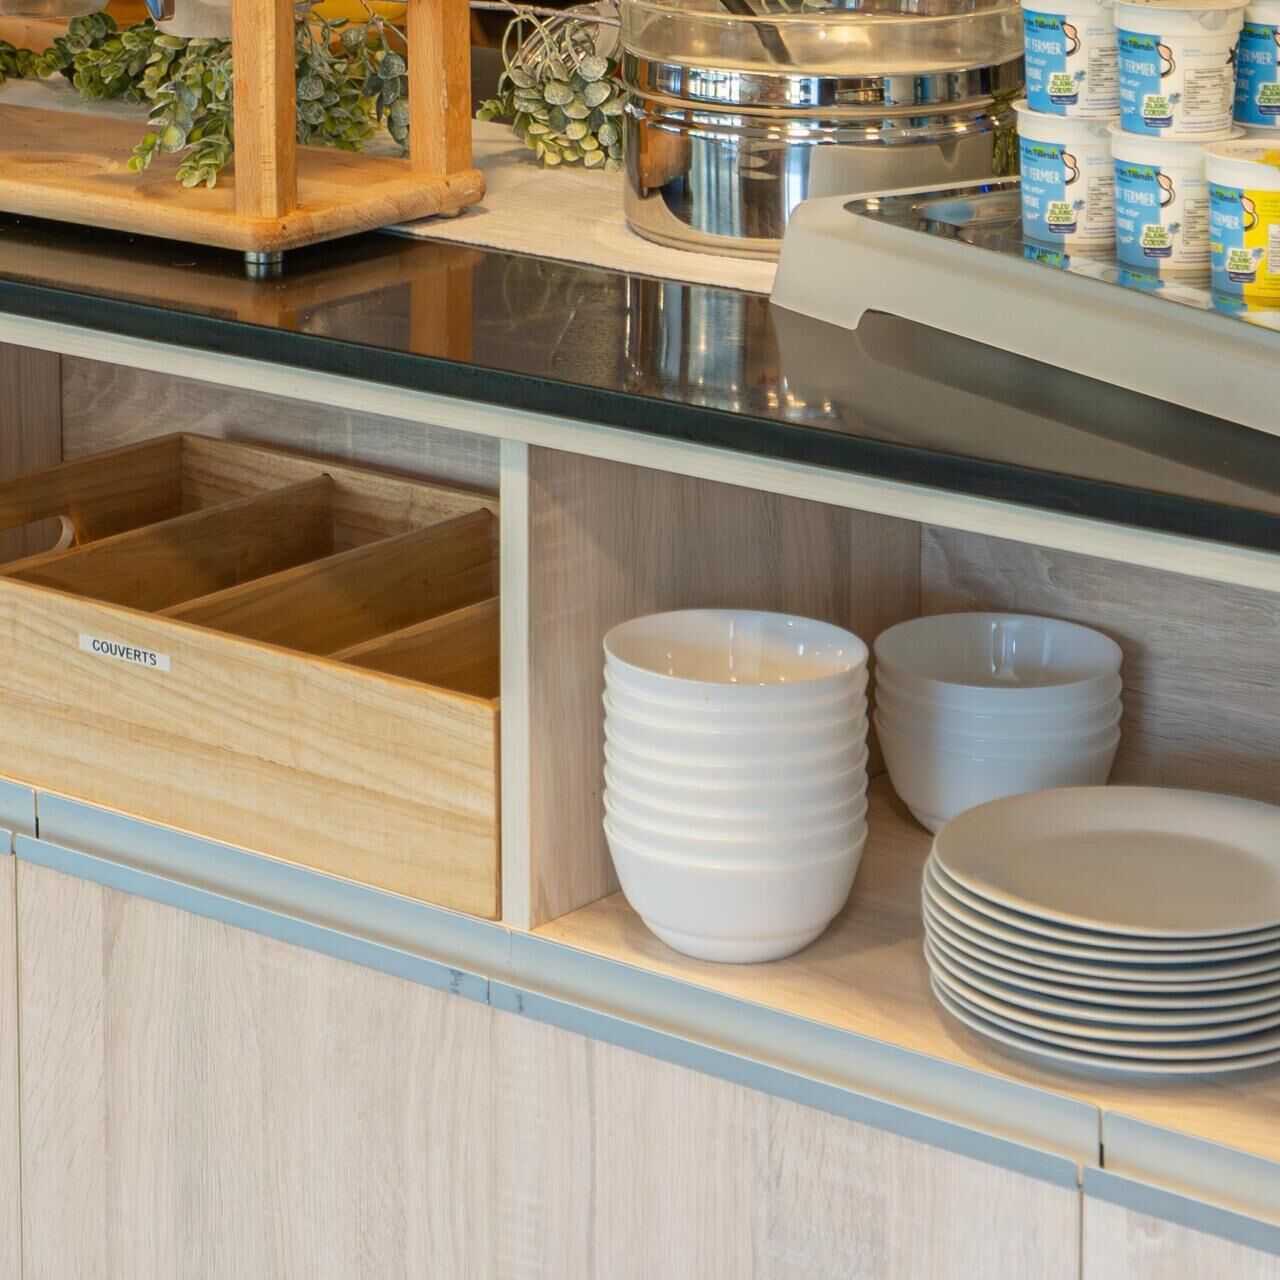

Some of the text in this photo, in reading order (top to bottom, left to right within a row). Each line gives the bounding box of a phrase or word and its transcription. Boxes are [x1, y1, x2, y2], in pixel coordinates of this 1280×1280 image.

[1031, 39, 1063, 56] FERMIER
[1125, 59, 1158, 77] FERMIER
[1051, 80, 1074, 88] BLANC
[1144, 102, 1169, 110] BLANC
[1030, 168, 1063, 185] FERMIER
[1124, 190, 1158, 207] FERMIER
[1050, 208, 1074, 216] BLANC
[1147, 225, 1166, 233] BLEU
[1144, 231, 1169, 239] BLANC
[1231, 249, 1249, 257] BLEU
[1229, 256, 1251, 264] BLANC
[91, 638, 158, 667] COUVERTS
